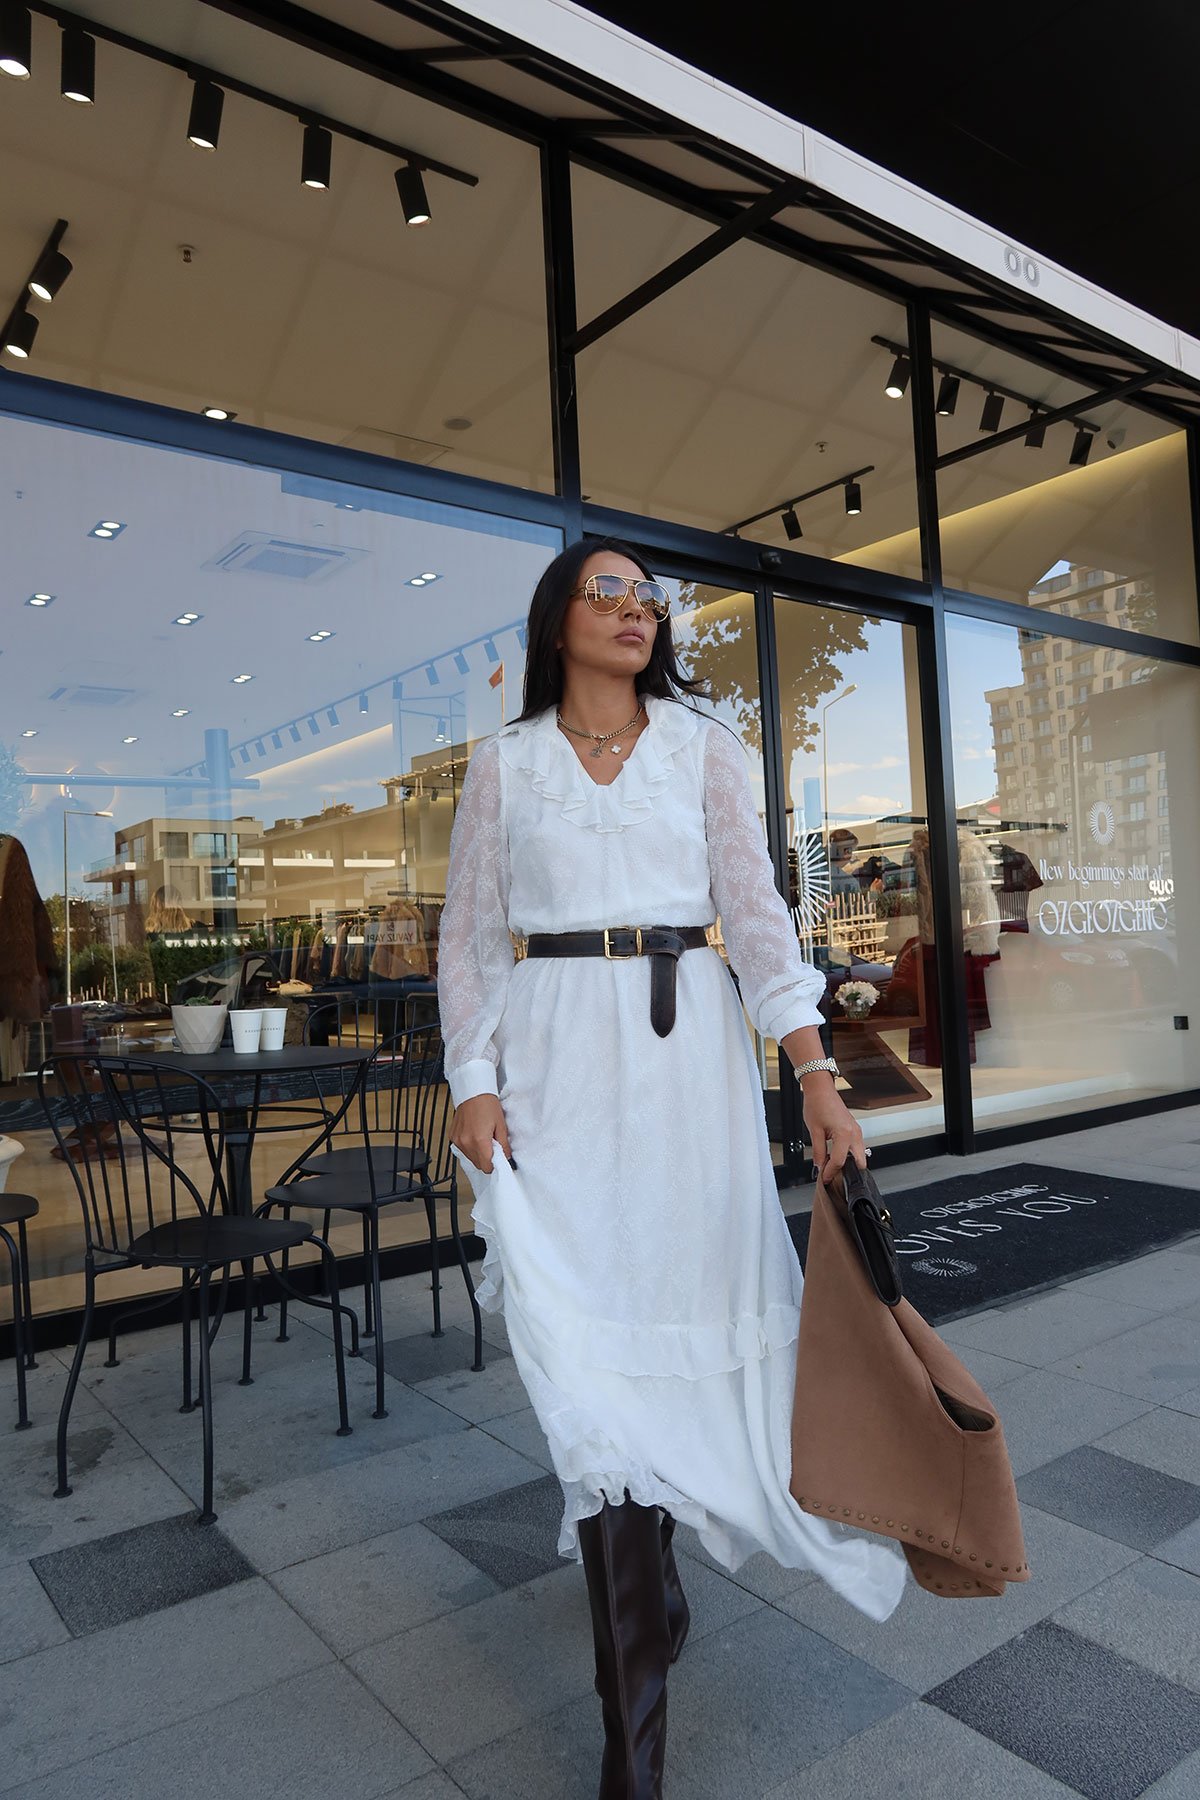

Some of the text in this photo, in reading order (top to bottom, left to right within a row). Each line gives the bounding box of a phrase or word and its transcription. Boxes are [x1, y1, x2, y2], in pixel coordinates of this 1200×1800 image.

[1039, 859, 1064, 881] New
[1068, 860, 1125, 889] beginnings
[1128, 864, 1149, 881] start
[894, 1218, 1002, 1254] OVES
